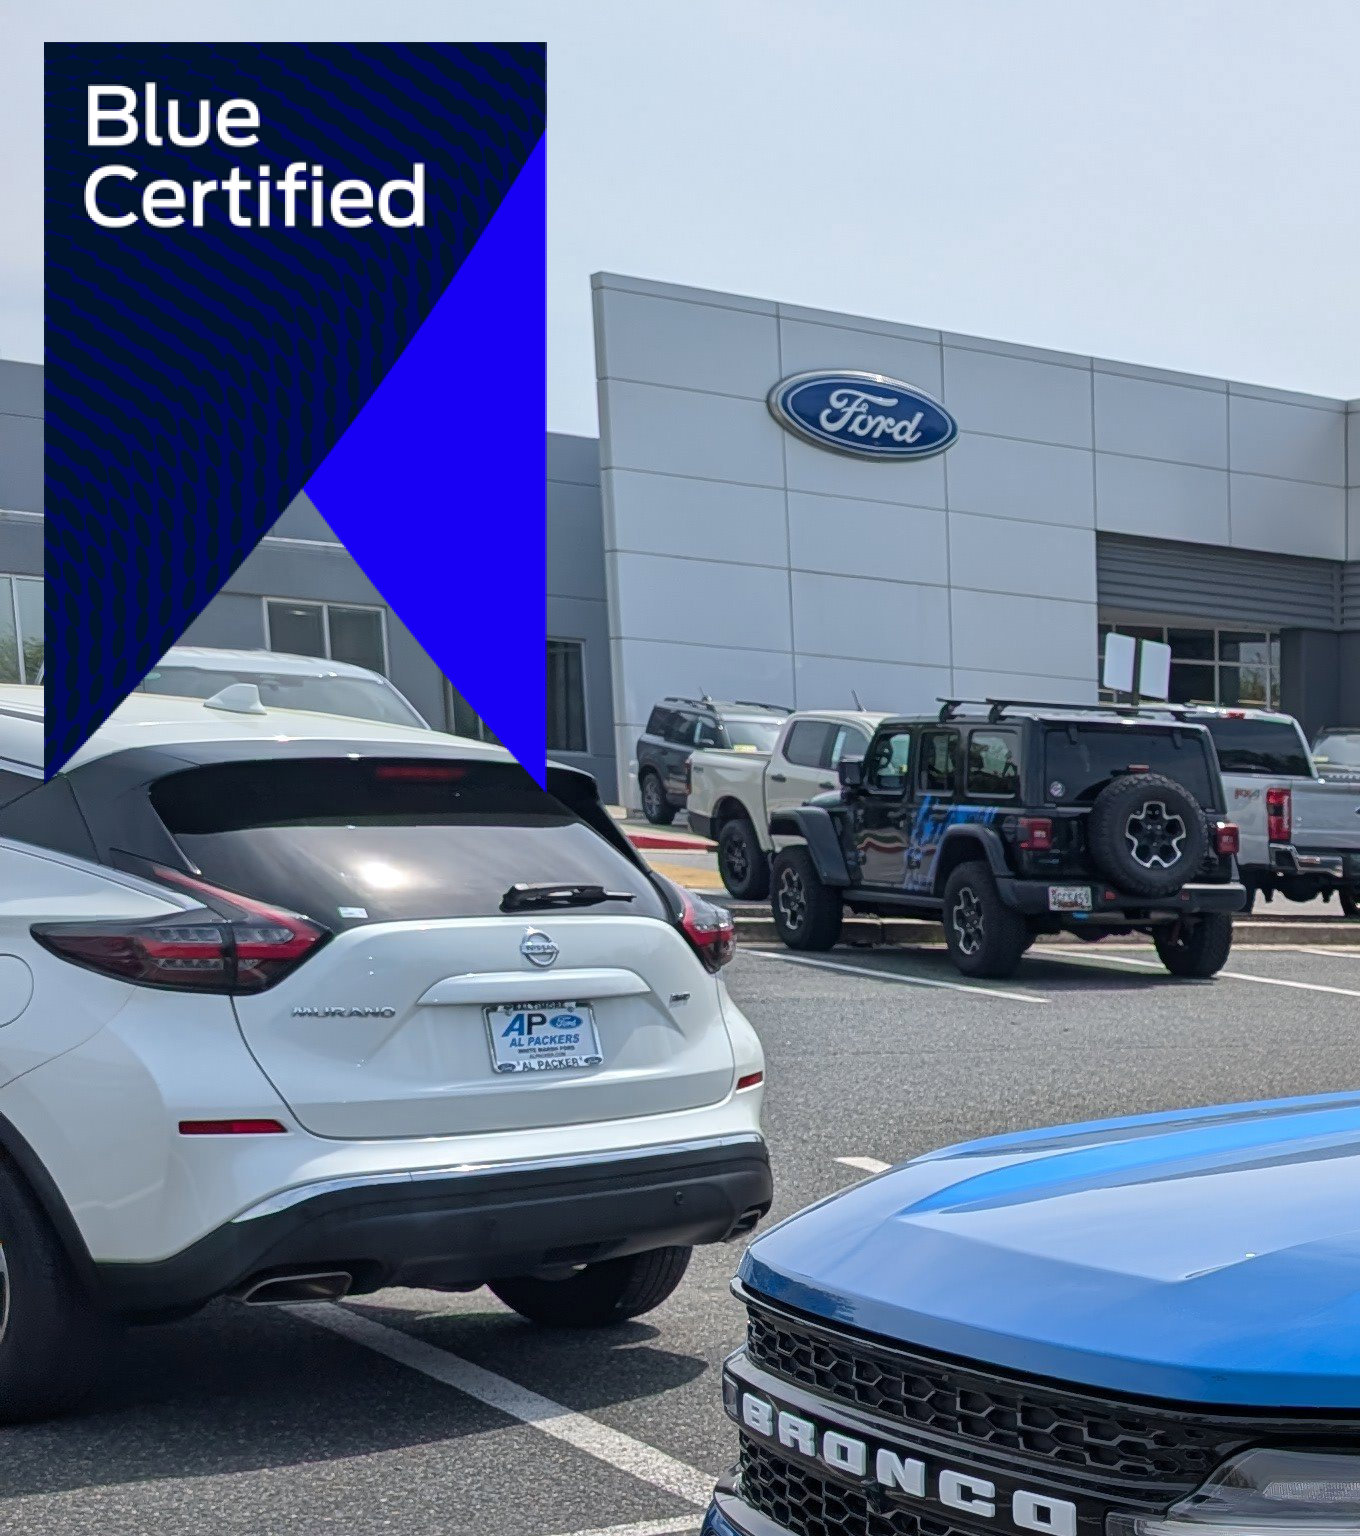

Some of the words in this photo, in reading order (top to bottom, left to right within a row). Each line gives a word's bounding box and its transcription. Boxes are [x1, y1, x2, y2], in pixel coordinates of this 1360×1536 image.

[818, 388, 925, 444] Ford
[525, 943, 556, 953] NISSAN
[291, 1005, 397, 1019] MURANO
[501, 1012, 547, 1038] AP
[509, 1037, 525, 1048] AL
[527, 1033, 580, 1047] PACKERS
